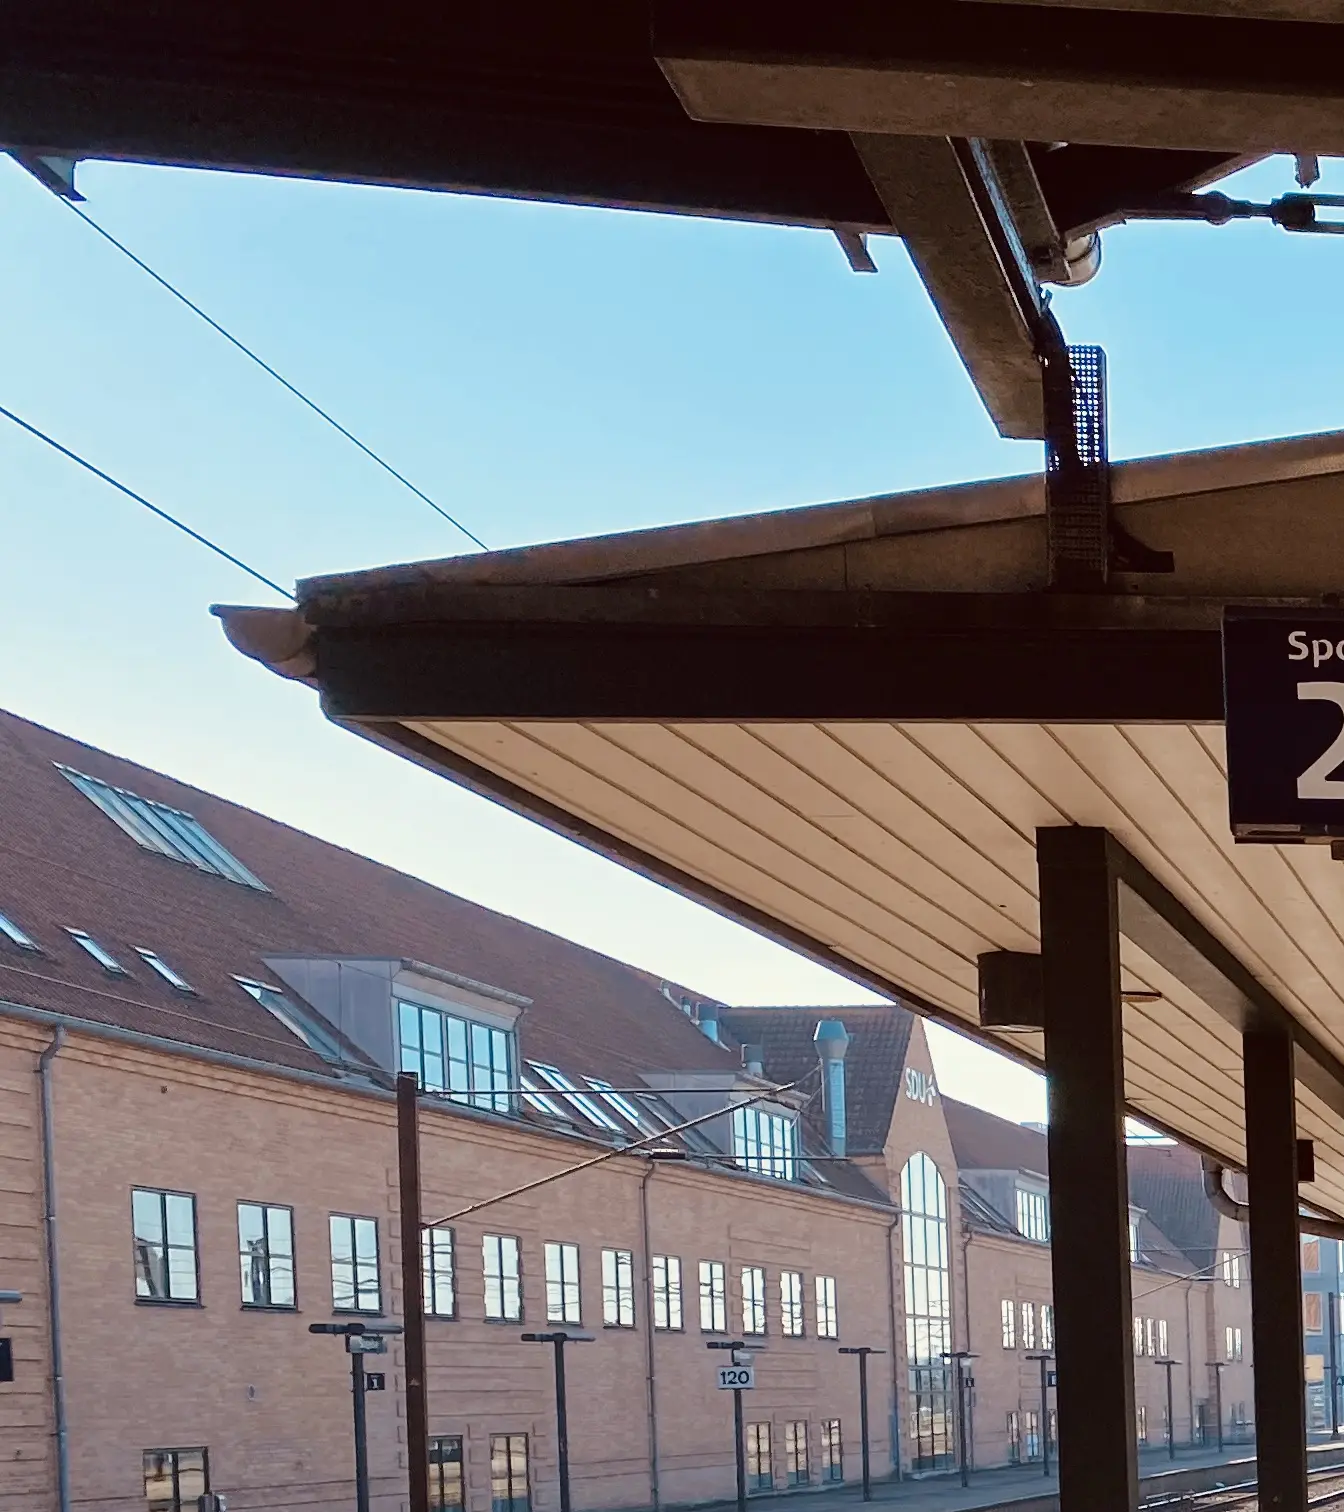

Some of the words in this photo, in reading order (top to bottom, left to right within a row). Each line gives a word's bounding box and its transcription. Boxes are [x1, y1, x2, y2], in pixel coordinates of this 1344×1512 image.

[905, 1067, 925, 1104] SDU
[371, 1378, 379, 1389] 1
[720, 1370, 750, 1385] 120
